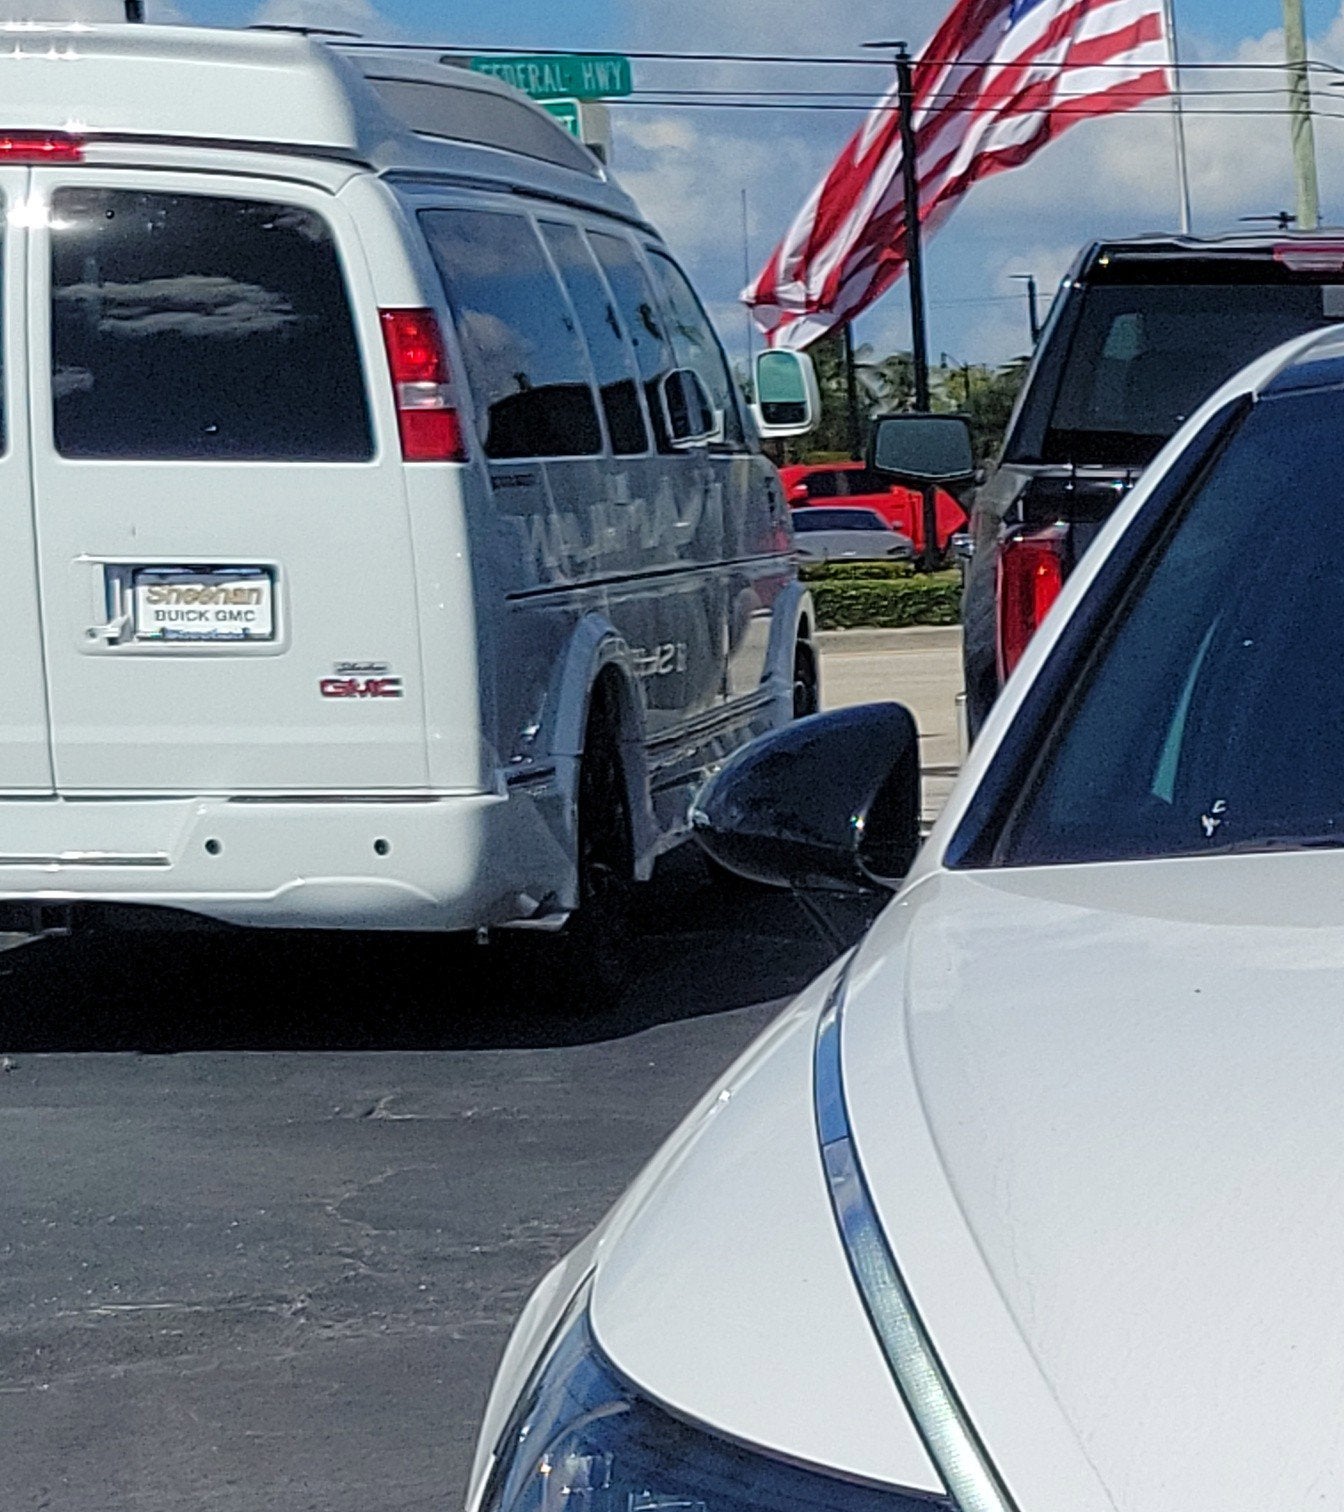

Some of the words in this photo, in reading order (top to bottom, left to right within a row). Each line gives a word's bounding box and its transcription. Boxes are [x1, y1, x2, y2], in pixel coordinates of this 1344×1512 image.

[480, 63, 568, 94] EDERAL
[580, 62, 622, 91] HWY
[155, 609, 210, 622] BUICK
[215, 609, 256, 622] GMC
[319, 678, 403, 698] GMC
